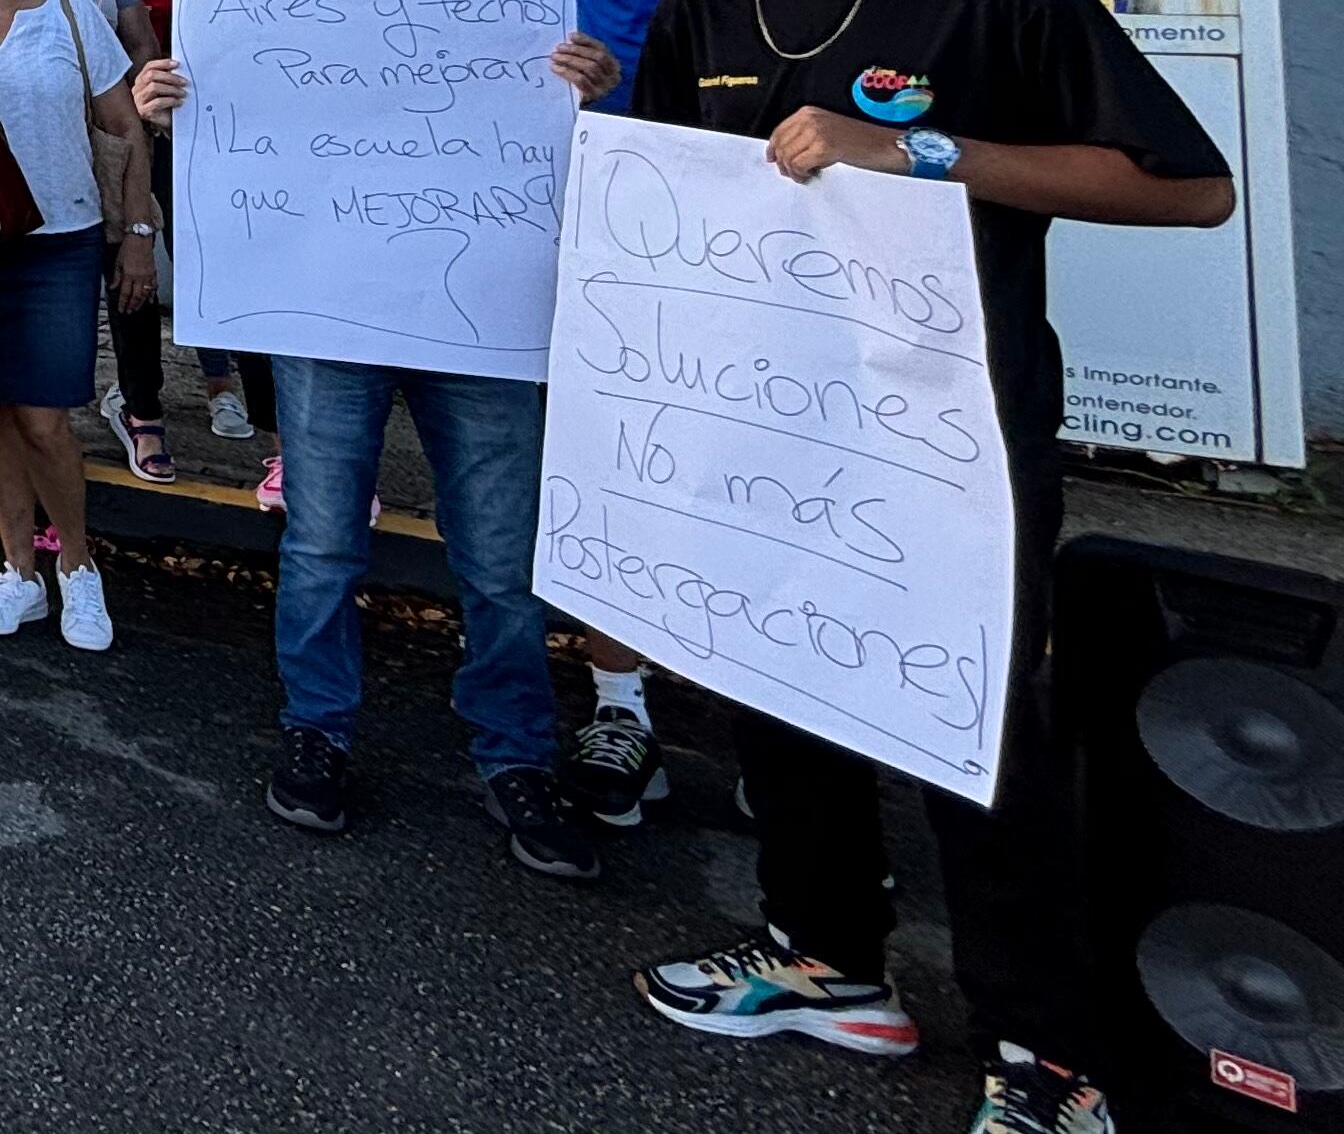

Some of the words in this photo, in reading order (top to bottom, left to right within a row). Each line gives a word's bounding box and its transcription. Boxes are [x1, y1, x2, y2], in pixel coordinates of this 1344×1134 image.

[1123, 25, 1226, 42] omento
[252, 46, 369, 90] Para
[378, 49, 552, 114] mejorar,
[309, 115, 482, 159] escuela
[492, 119, 556, 205] hay
[229, 188, 305, 241] que
[575, 269, 981, 464] Soluciones
[1065, 367, 1076, 380] s
[1083, 365, 1223, 395] Importante.
[1061, 412, 1232, 449] cling.com
[1066, 392, 1199, 421] ontenedor.
[616, 402, 677, 485] No
[721, 466, 906, 564] más
